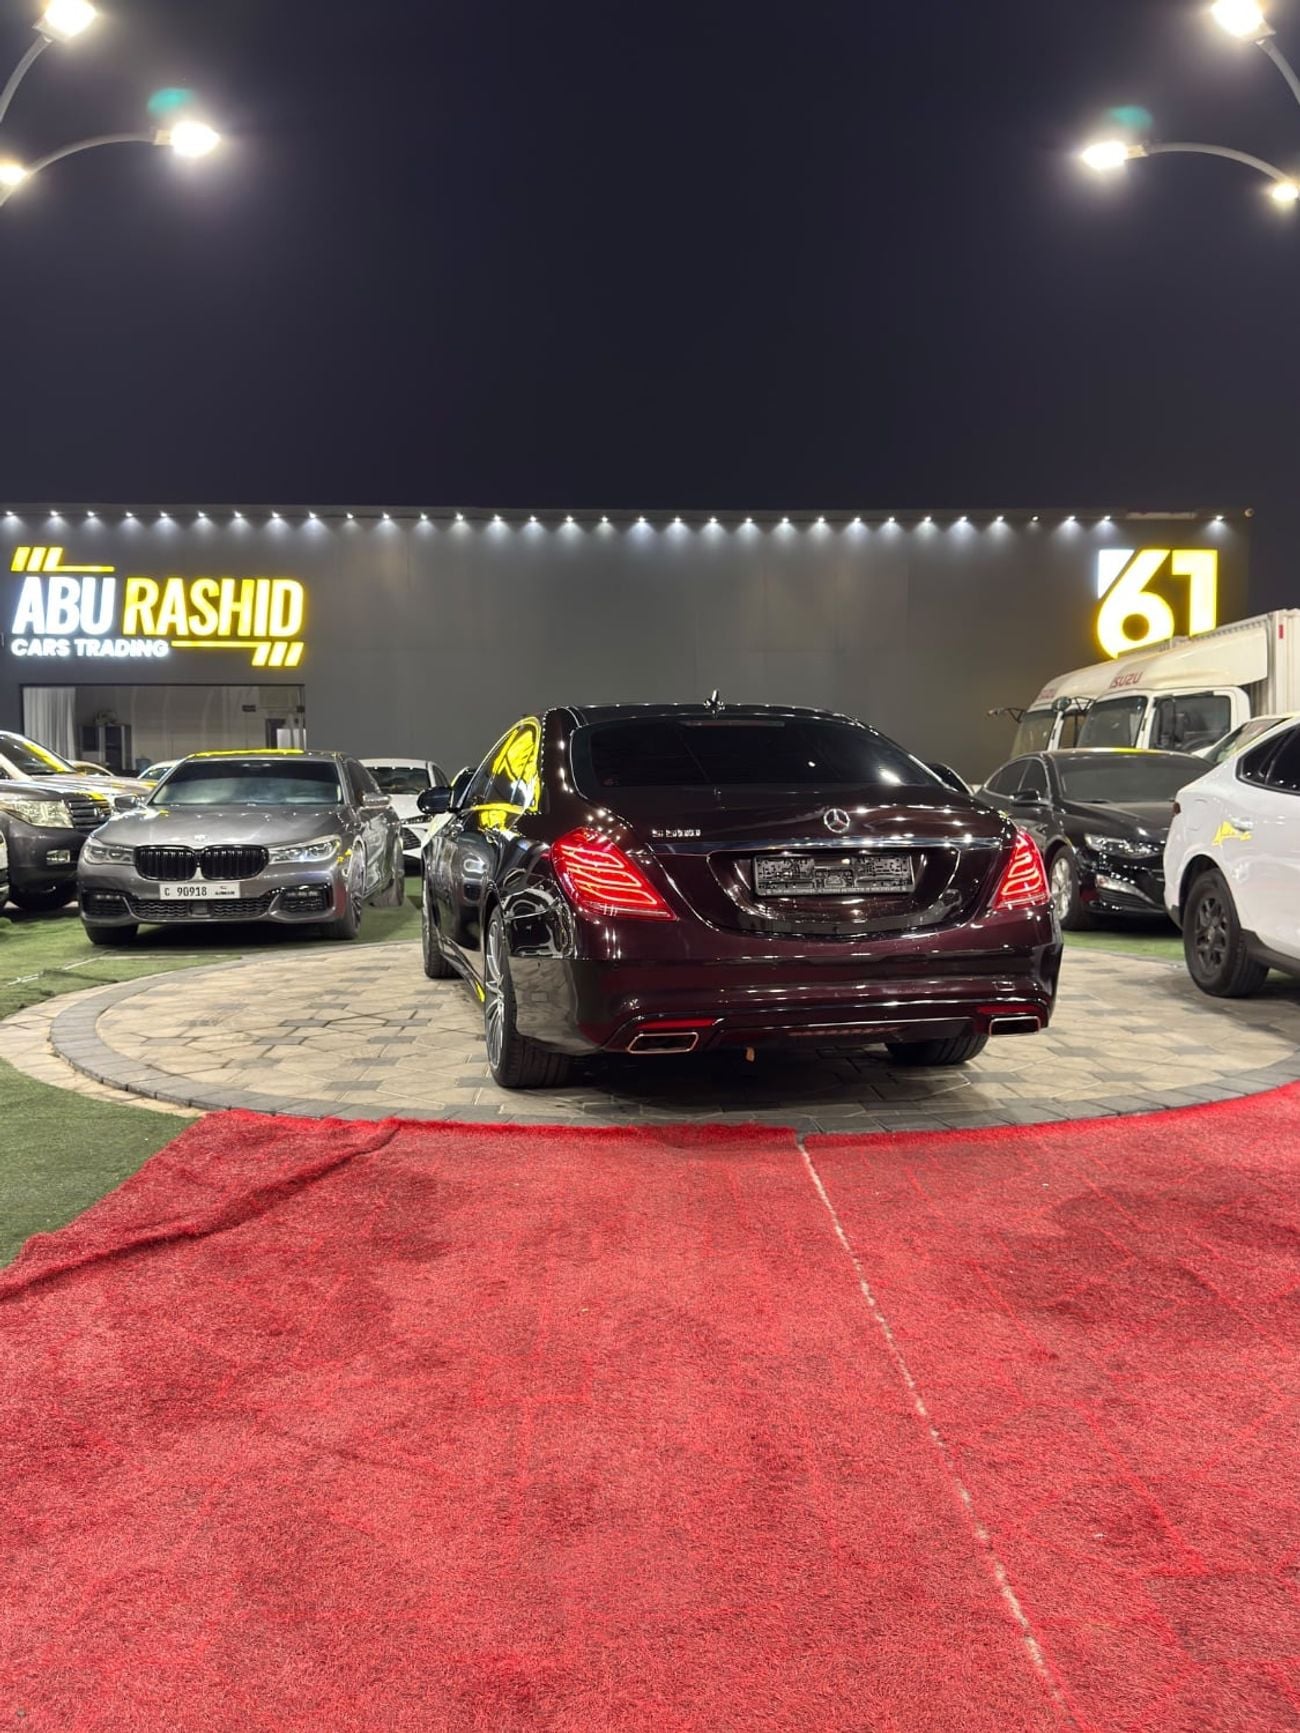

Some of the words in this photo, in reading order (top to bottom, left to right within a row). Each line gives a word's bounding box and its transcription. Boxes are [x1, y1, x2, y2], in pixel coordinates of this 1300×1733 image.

[11, 576, 116, 635] ABU
[122, 577, 304, 637] RASHID
[1097, 549, 1218, 660] 61
[11, 638, 70, 657] CARS
[74, 638, 170, 658] TRADING
[1109, 672, 1143, 689] ISUZU
[164, 887, 170, 896] C
[177, 886, 207, 896] 90918
